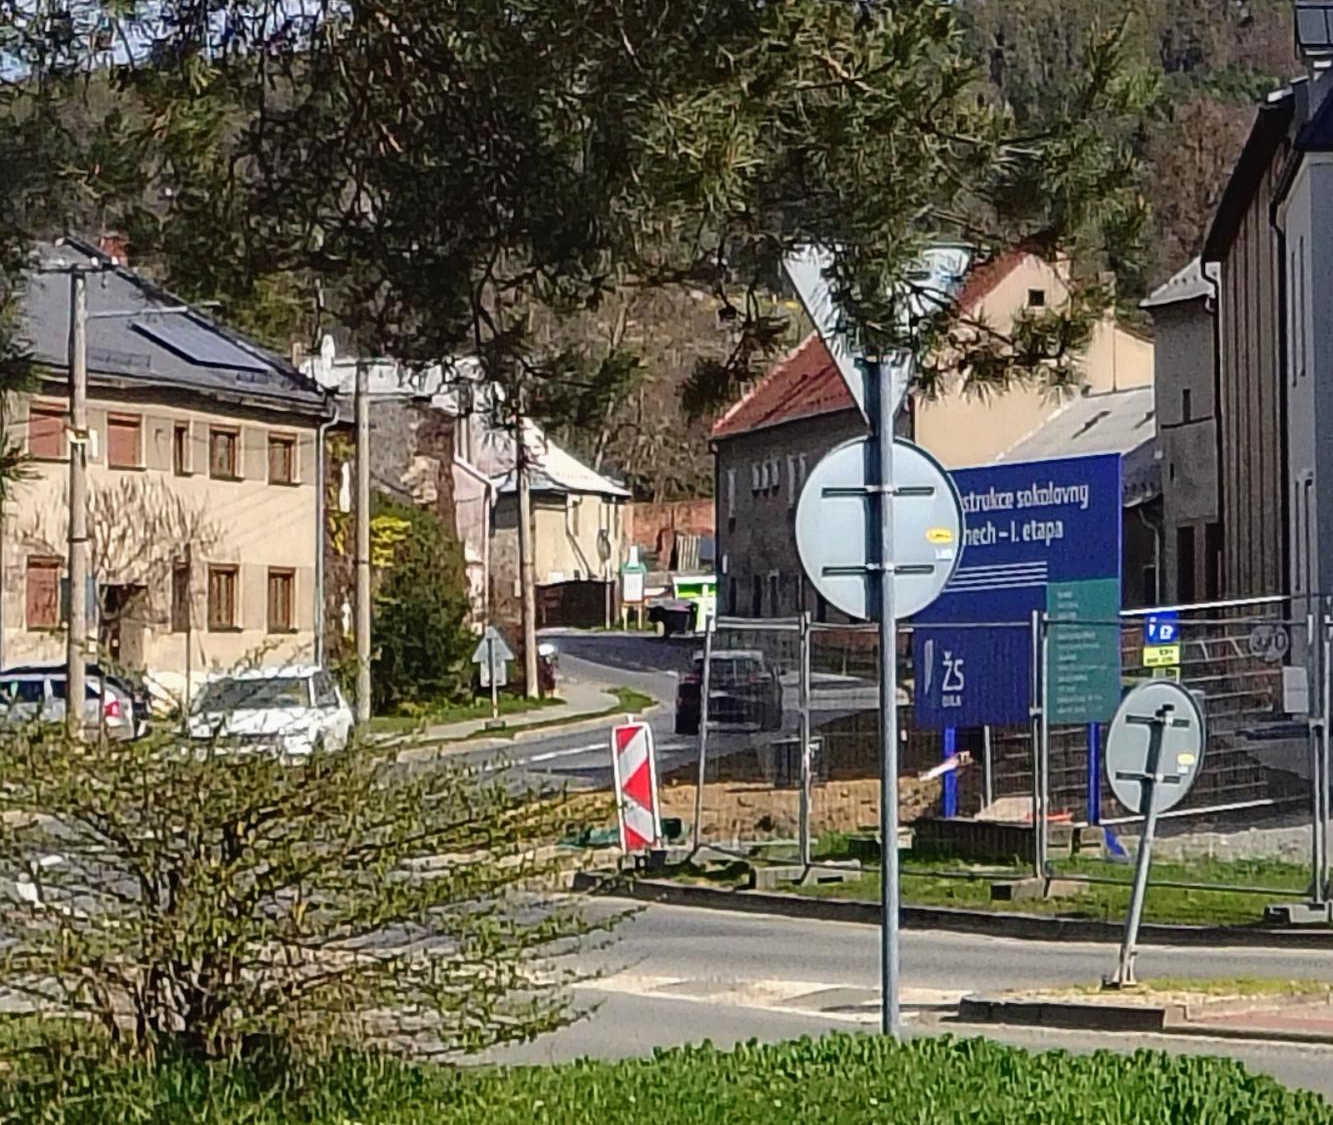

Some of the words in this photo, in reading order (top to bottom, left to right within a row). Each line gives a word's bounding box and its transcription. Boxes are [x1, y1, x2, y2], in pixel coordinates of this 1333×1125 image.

[962, 486, 1014, 512] strukce
[1017, 480, 1089, 509] sokolovny
[963, 521, 996, 546] nech
[1022, 520, 1064, 546] etapa
[942, 651, 965, 691] ŽS
